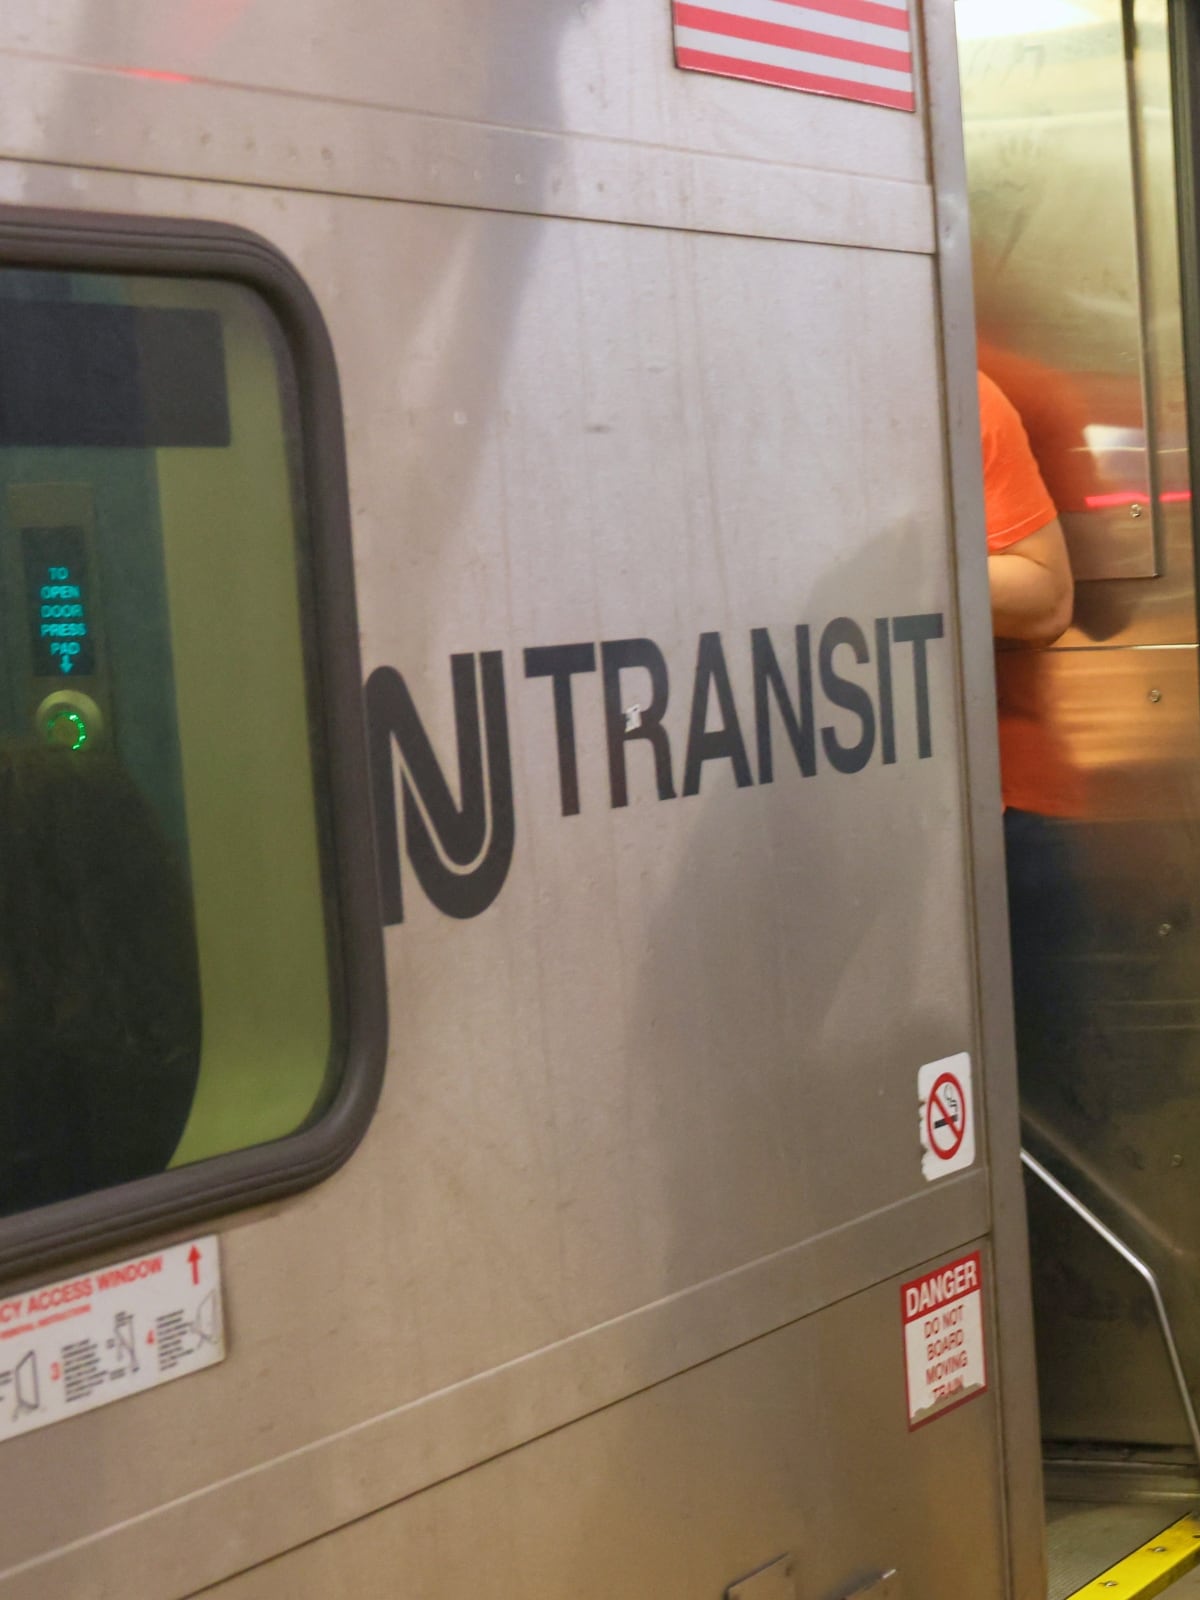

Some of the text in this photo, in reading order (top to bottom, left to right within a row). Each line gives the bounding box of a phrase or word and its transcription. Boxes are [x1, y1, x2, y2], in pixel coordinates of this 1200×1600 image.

[48, 567, 69, 580] TO
[40, 585, 80, 600] OPEN
[40, 604, 83, 618] DOOR
[40, 623, 87, 637] PRESS
[50, 642, 80, 655] PAD
[364, 613, 944, 928] NJ TRANSIT
[27, 1279, 93, 1313] ACCESS
[97, 1257, 163, 1290] WINDOW
[907, 1261, 977, 1317] DANGER
[924, 1303, 964, 1339] DO NOT
[926, 1328, 965, 1361] BOARD
[925, 1350, 968, 1385] MOVING
